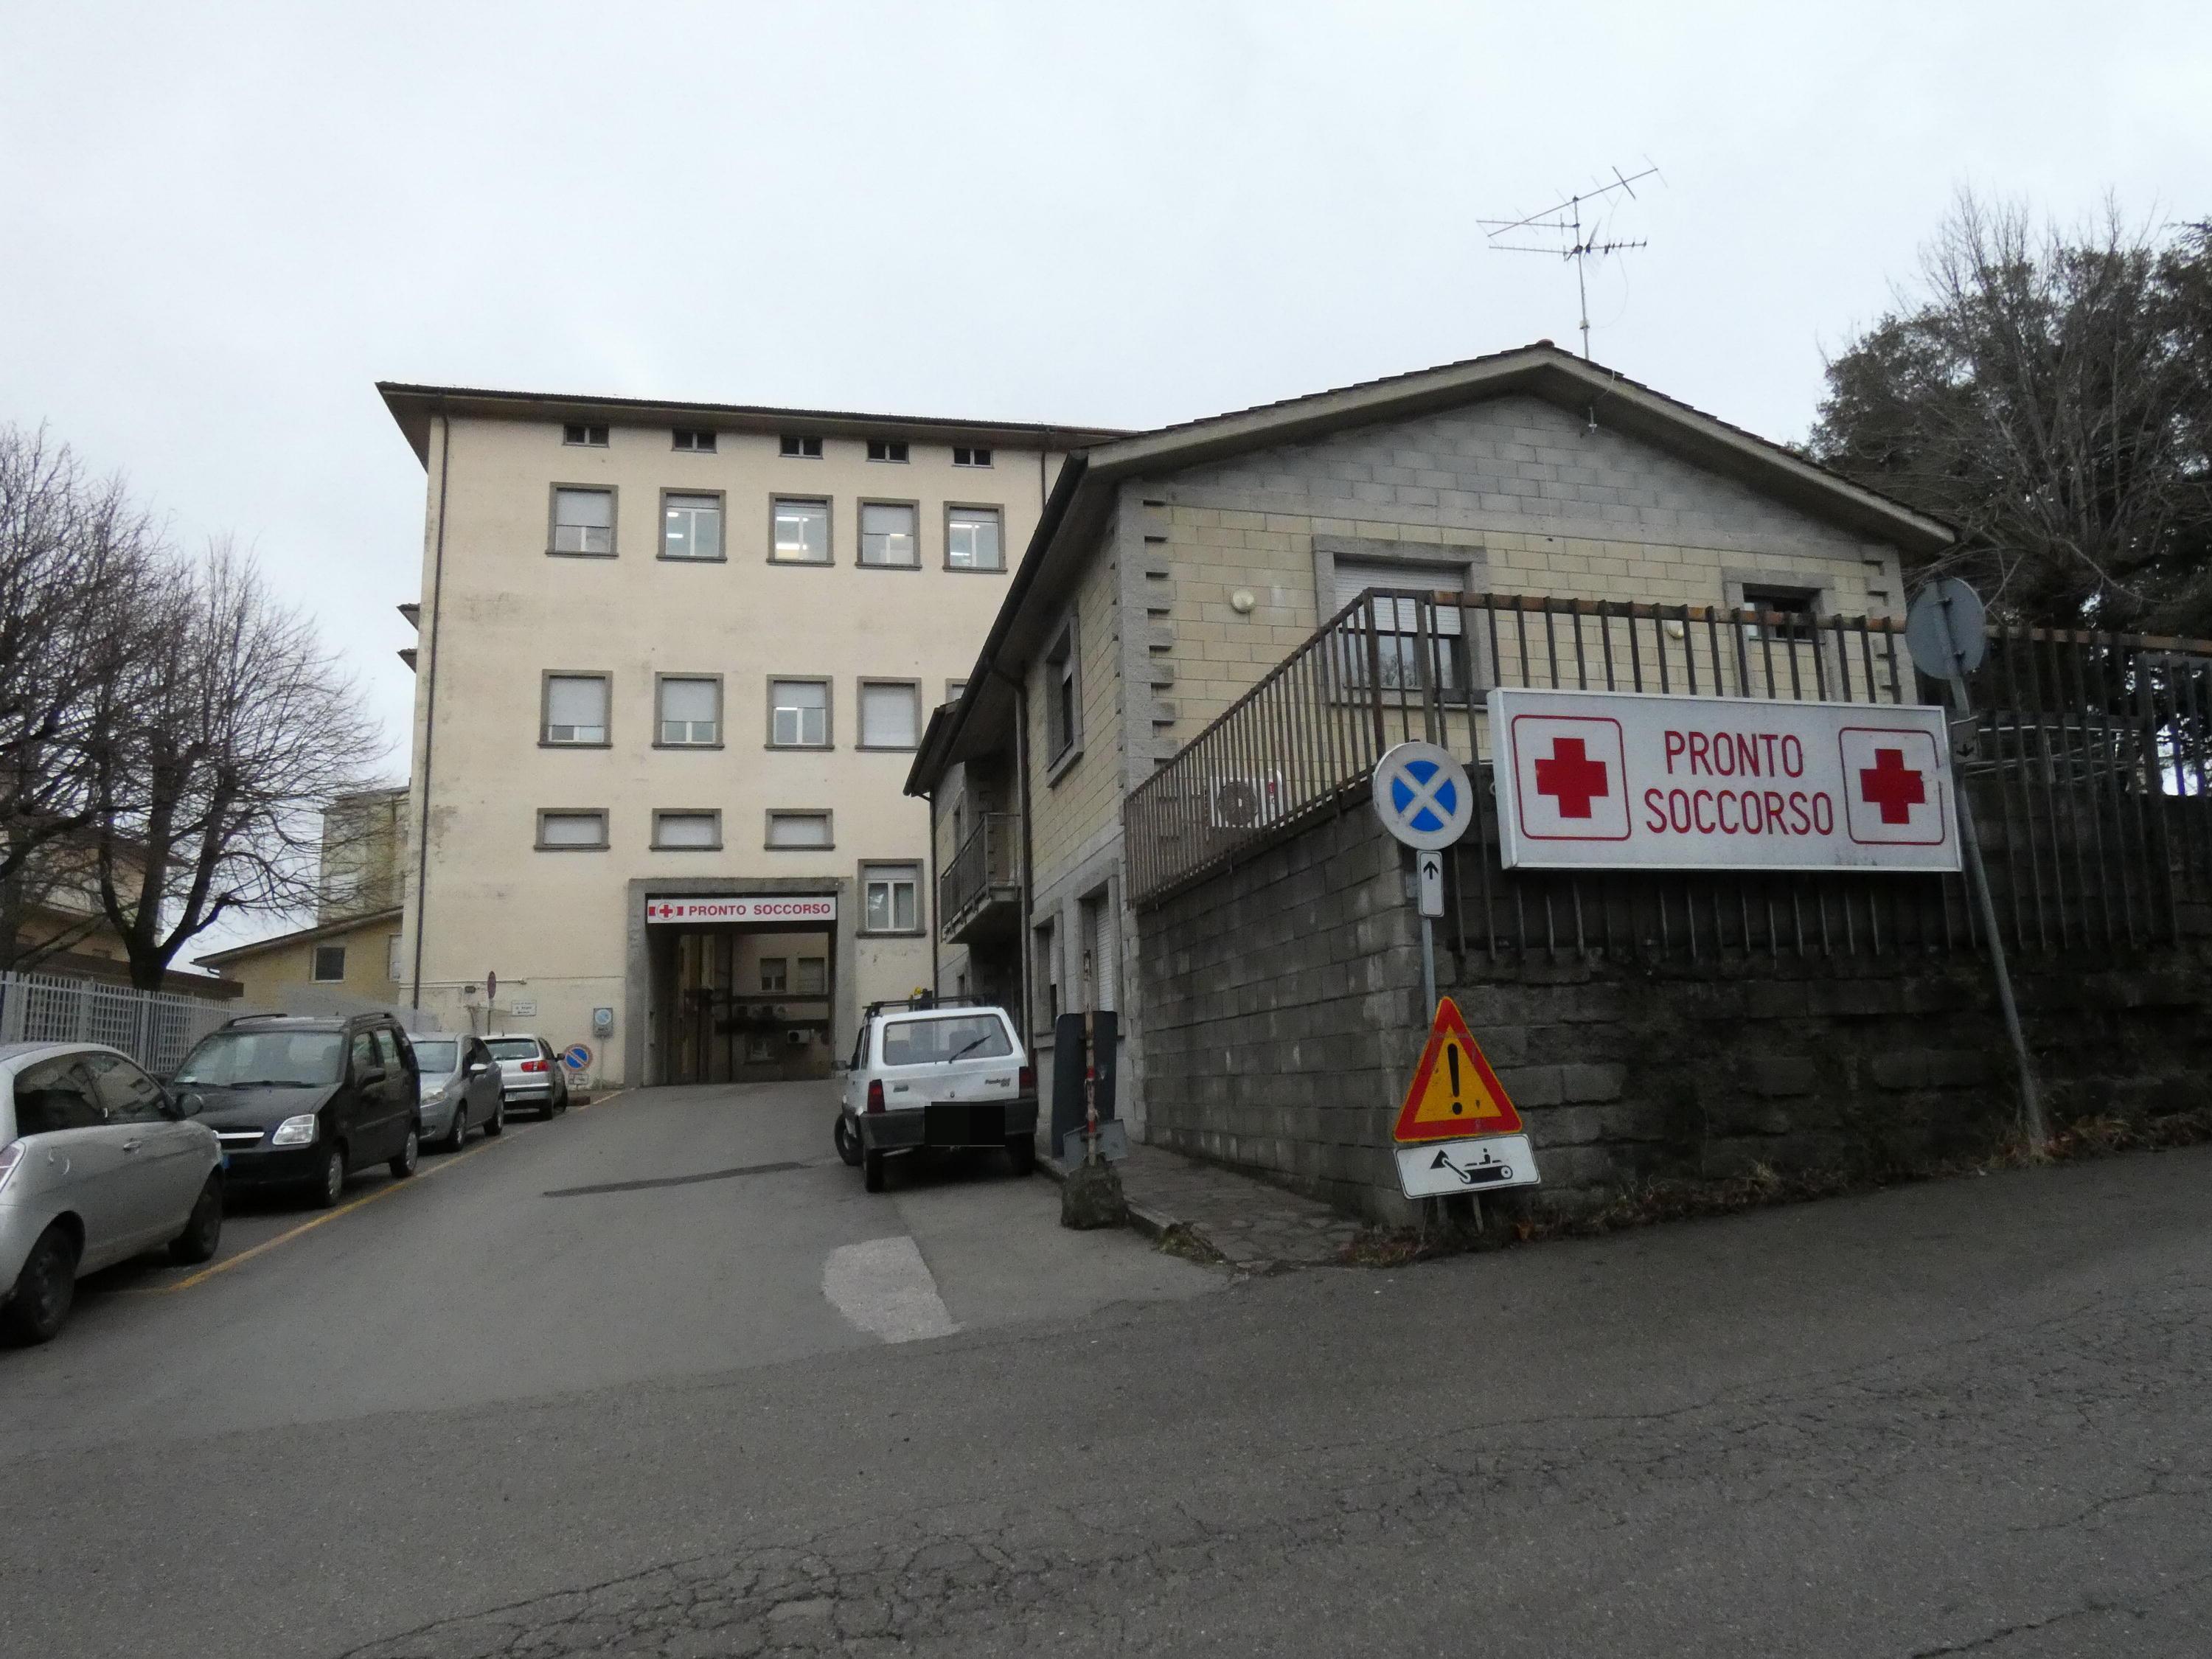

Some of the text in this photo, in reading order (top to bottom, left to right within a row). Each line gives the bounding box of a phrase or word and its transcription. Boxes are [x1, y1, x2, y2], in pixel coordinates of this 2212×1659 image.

[1665, 730, 1804, 779] PRONTO
[1644, 787, 1834, 836] SOCCORSO
[689, 903, 831, 917] PRONTO SOCCORSO
